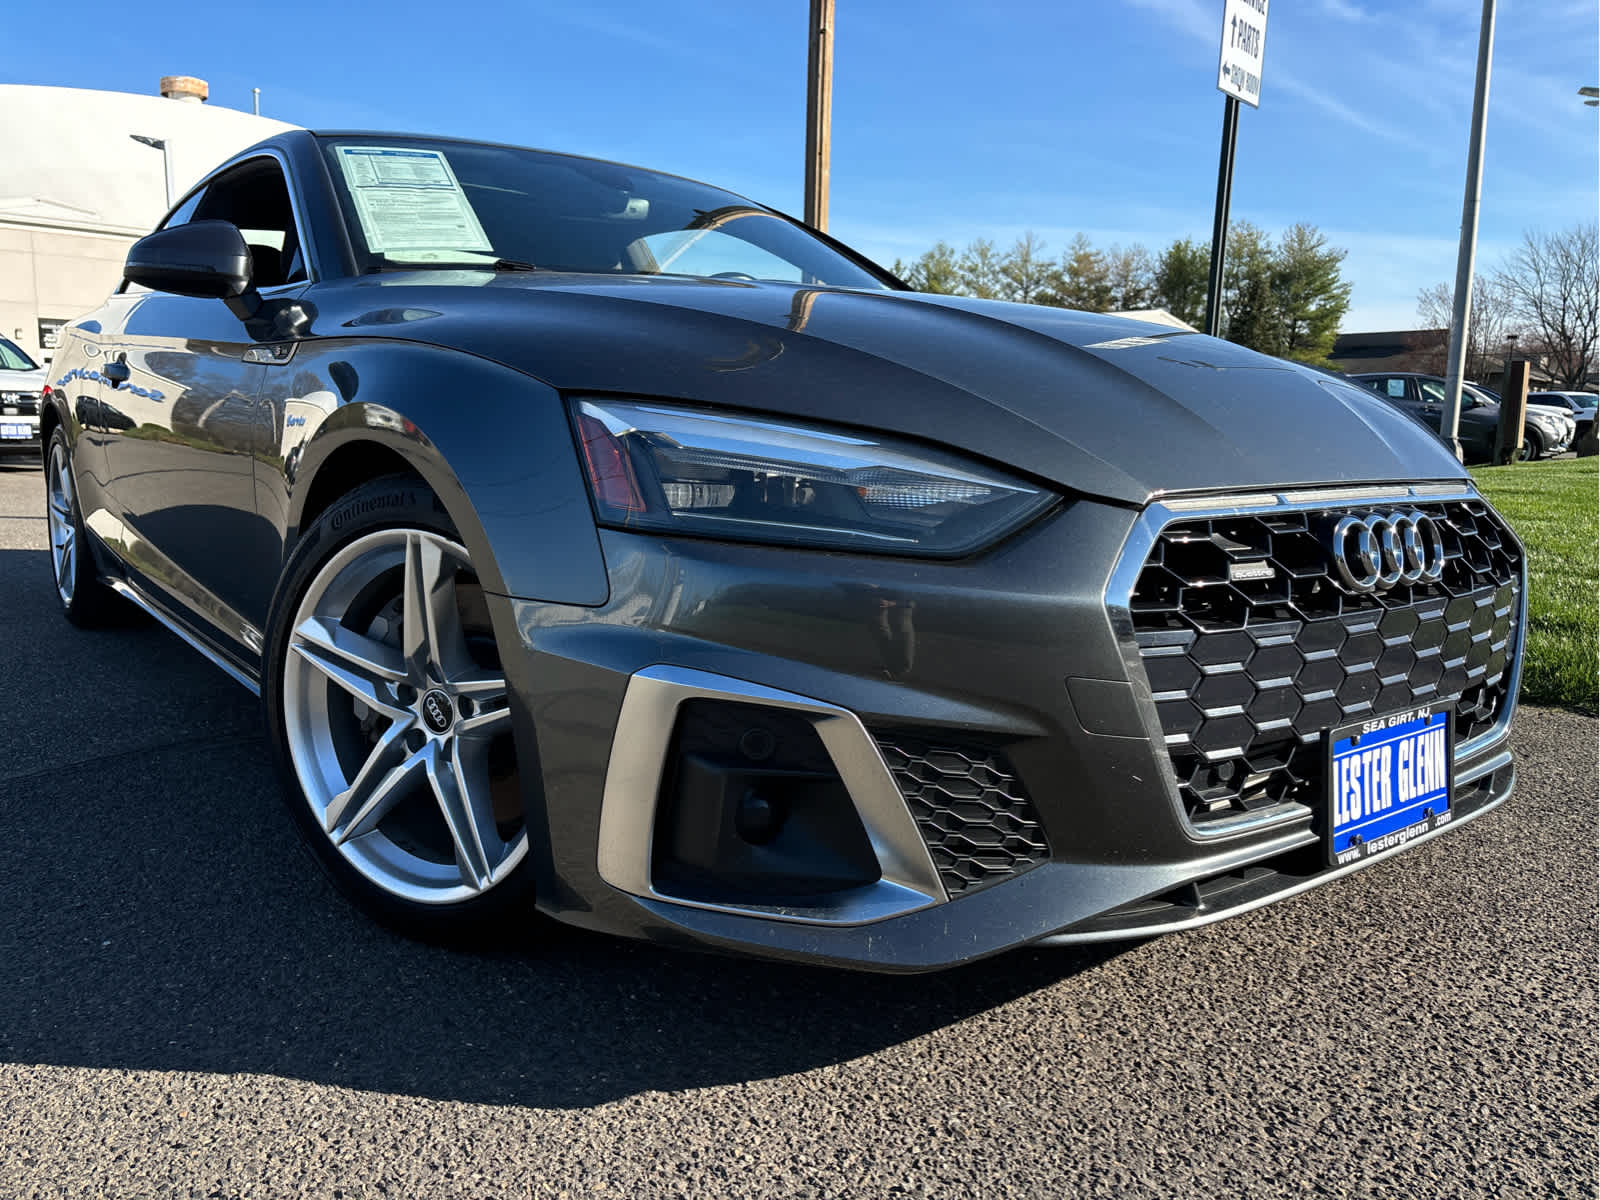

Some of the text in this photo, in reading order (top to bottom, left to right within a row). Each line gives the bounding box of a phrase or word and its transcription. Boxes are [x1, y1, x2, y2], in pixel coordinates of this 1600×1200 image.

[1237, 18, 1260, 59] PARTS
[1362, 721, 1386, 735] SEA
[1388, 713, 1416, 729] GIRT,
[1333, 728, 1446, 828] LESTER GLENN
[1337, 813, 1451, 865] www. lesterglenn .com
